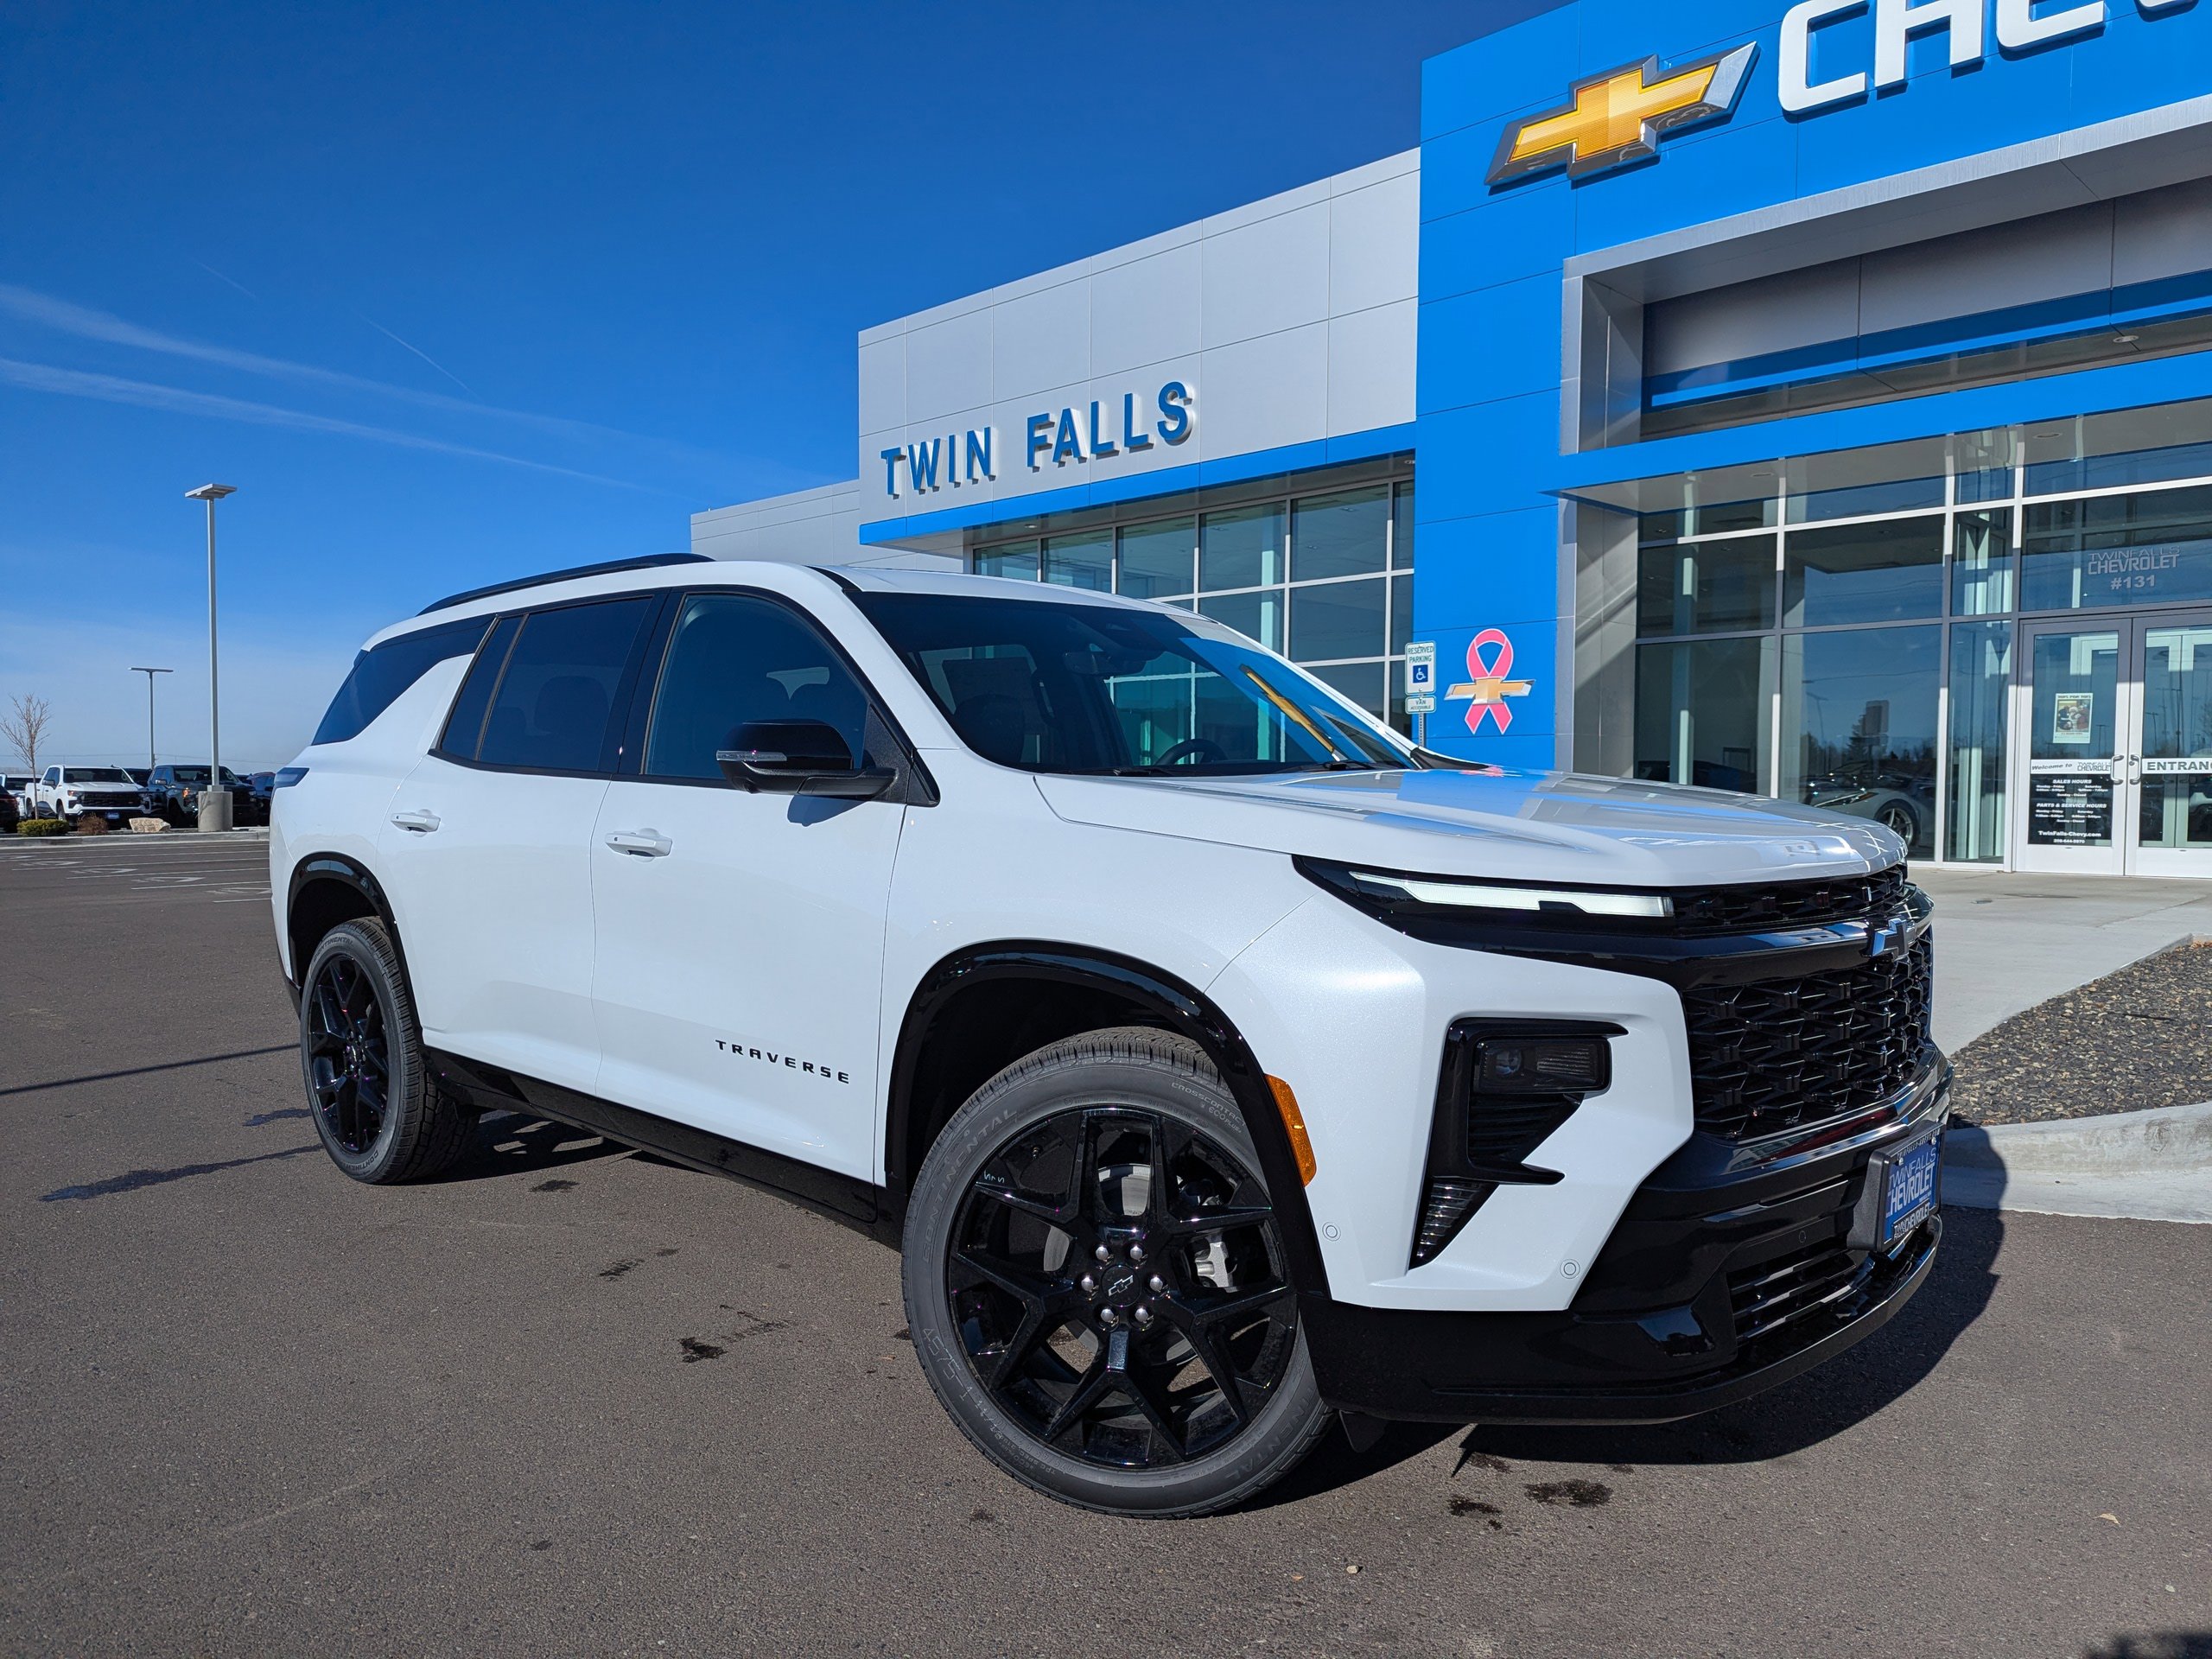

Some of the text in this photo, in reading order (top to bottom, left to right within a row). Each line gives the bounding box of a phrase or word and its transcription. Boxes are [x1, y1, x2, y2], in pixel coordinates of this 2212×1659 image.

[1778, 0, 2195, 111] CH
[881, 381, 1192, 498] TWIN FALLS
[2088, 554, 2179, 575] CHEVROLET
[2111, 575, 2155, 589] #131
[1408, 645, 1433, 654] RESERVED
[1409, 655, 1432, 664] PARKING
[2147, 761, 2212, 771] ENTRAN
[715, 1039, 849, 1084] TRAVERSE
[1889, 1147, 1937, 1191] TWINFALLS
[922, 1109, 1017, 1263] CONTINENTAL
